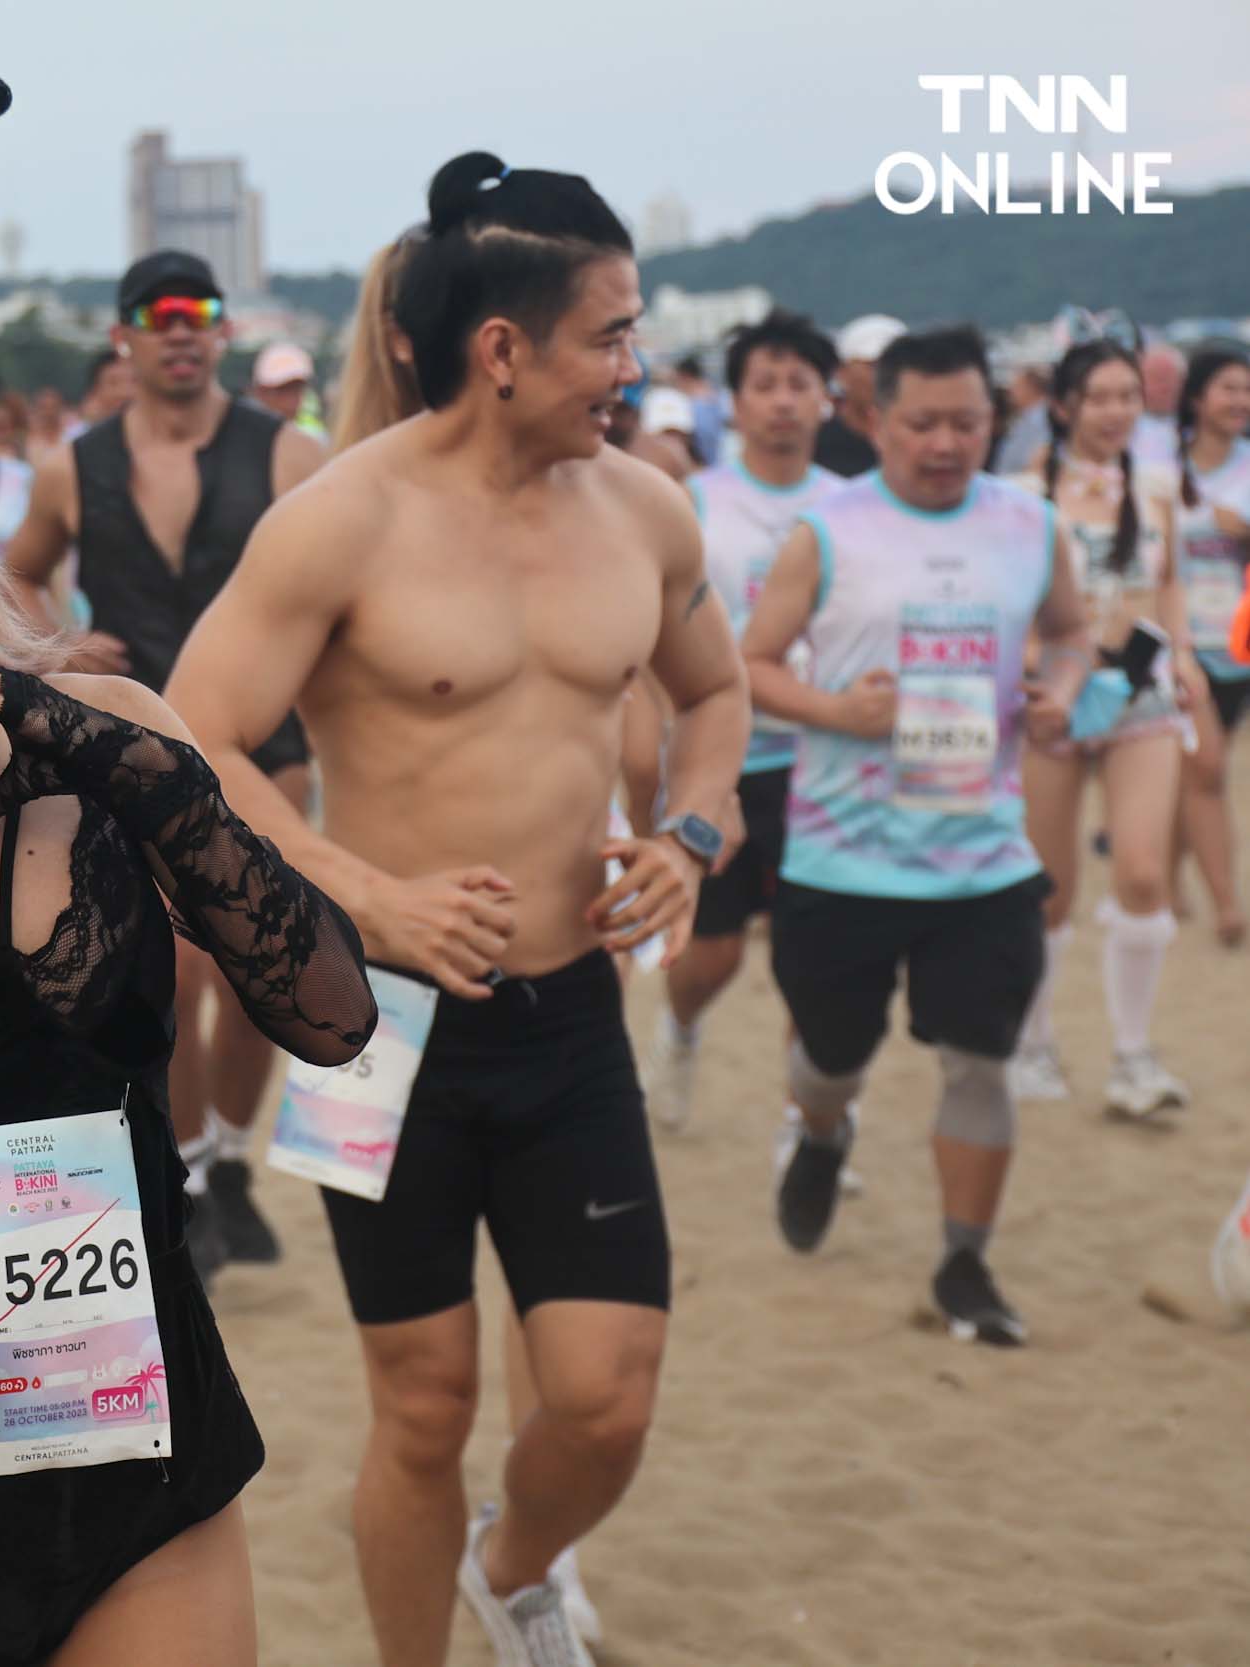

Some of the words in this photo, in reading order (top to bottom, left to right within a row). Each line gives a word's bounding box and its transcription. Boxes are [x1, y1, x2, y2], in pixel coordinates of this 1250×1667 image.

[7, 1134, 56, 1148] CENTRAL
[11, 1144, 54, 1156] PATTAYA
[14, 1159, 55, 1172] PATTAYA
[5, 1238, 139, 1305] 5226
[97, 1392, 140, 1413] 5KM
[4, 1407, 27, 1417] START
[30, 1403, 48, 1413] TIME
[18, 1411, 64, 1426] OCTOBER
[66, 1408, 88, 1419] 2023
